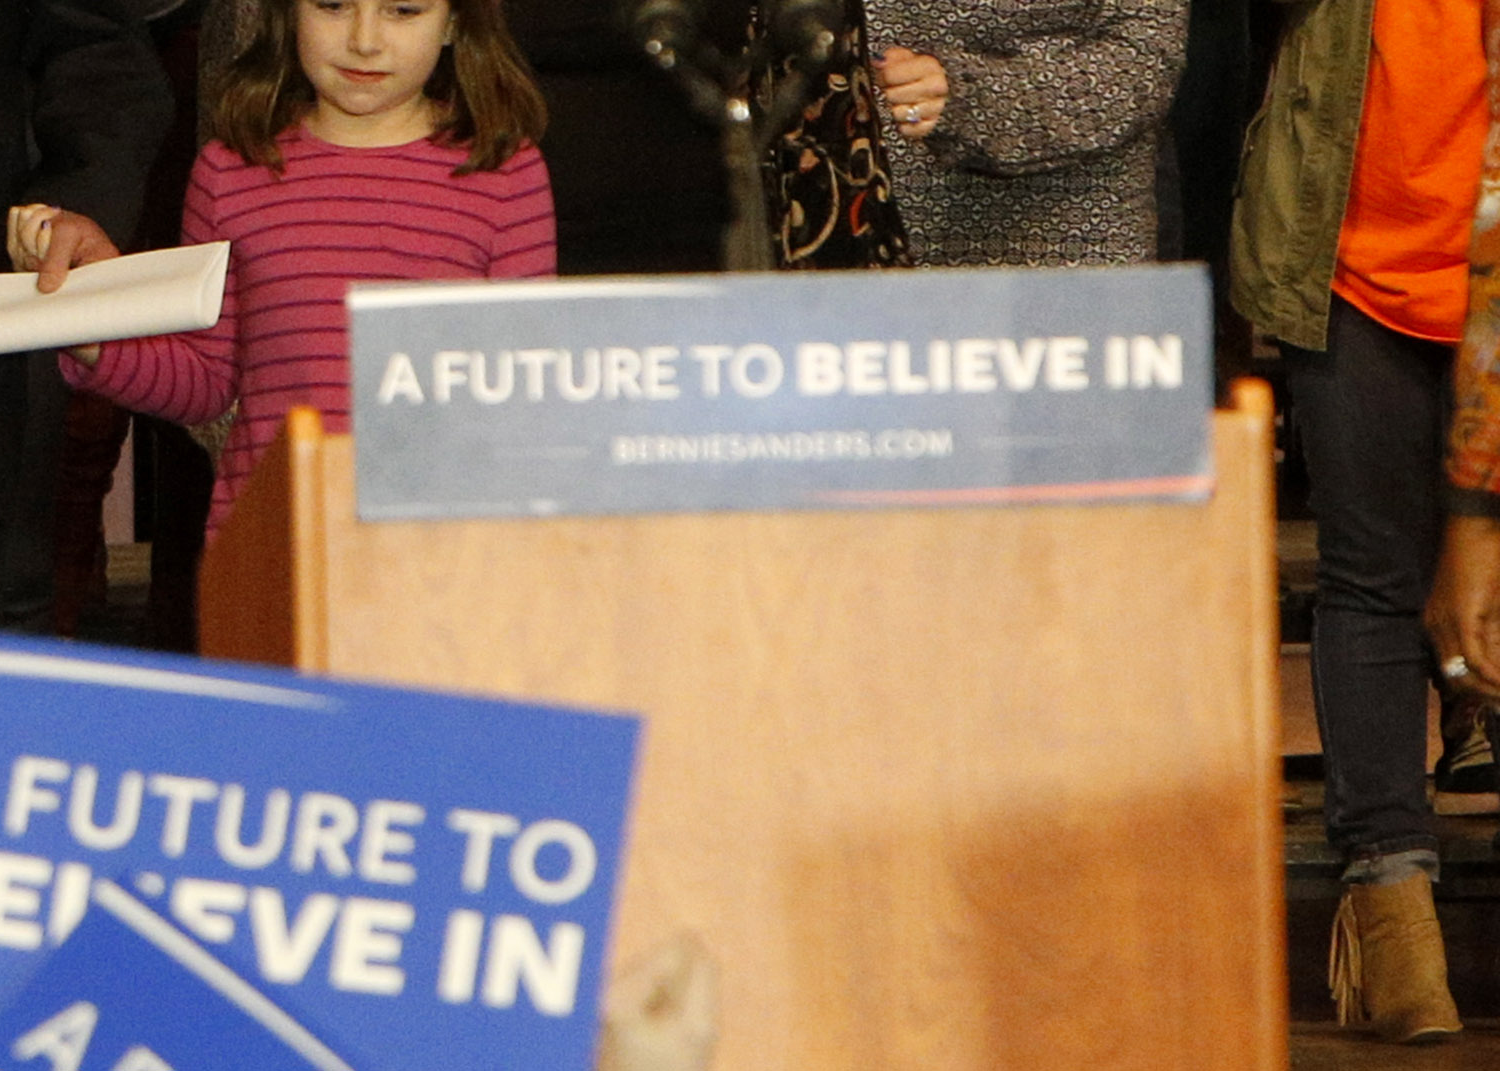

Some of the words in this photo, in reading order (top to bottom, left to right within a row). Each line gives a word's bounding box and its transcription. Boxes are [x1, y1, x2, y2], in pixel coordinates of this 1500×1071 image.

[377, 351, 424, 406] A
[432, 345, 681, 405] FUTURE
[700, 342, 785, 399] TO
[795, 336, 1089, 398] BELIEVE
[1108, 333, 1183, 390] IN
[610, 428, 954, 466] BERNIESANDERS.COM
[2, 754, 427, 886] FUTURE
[446, 806, 599, 906] TO
[436, 906, 585, 1019] IN
